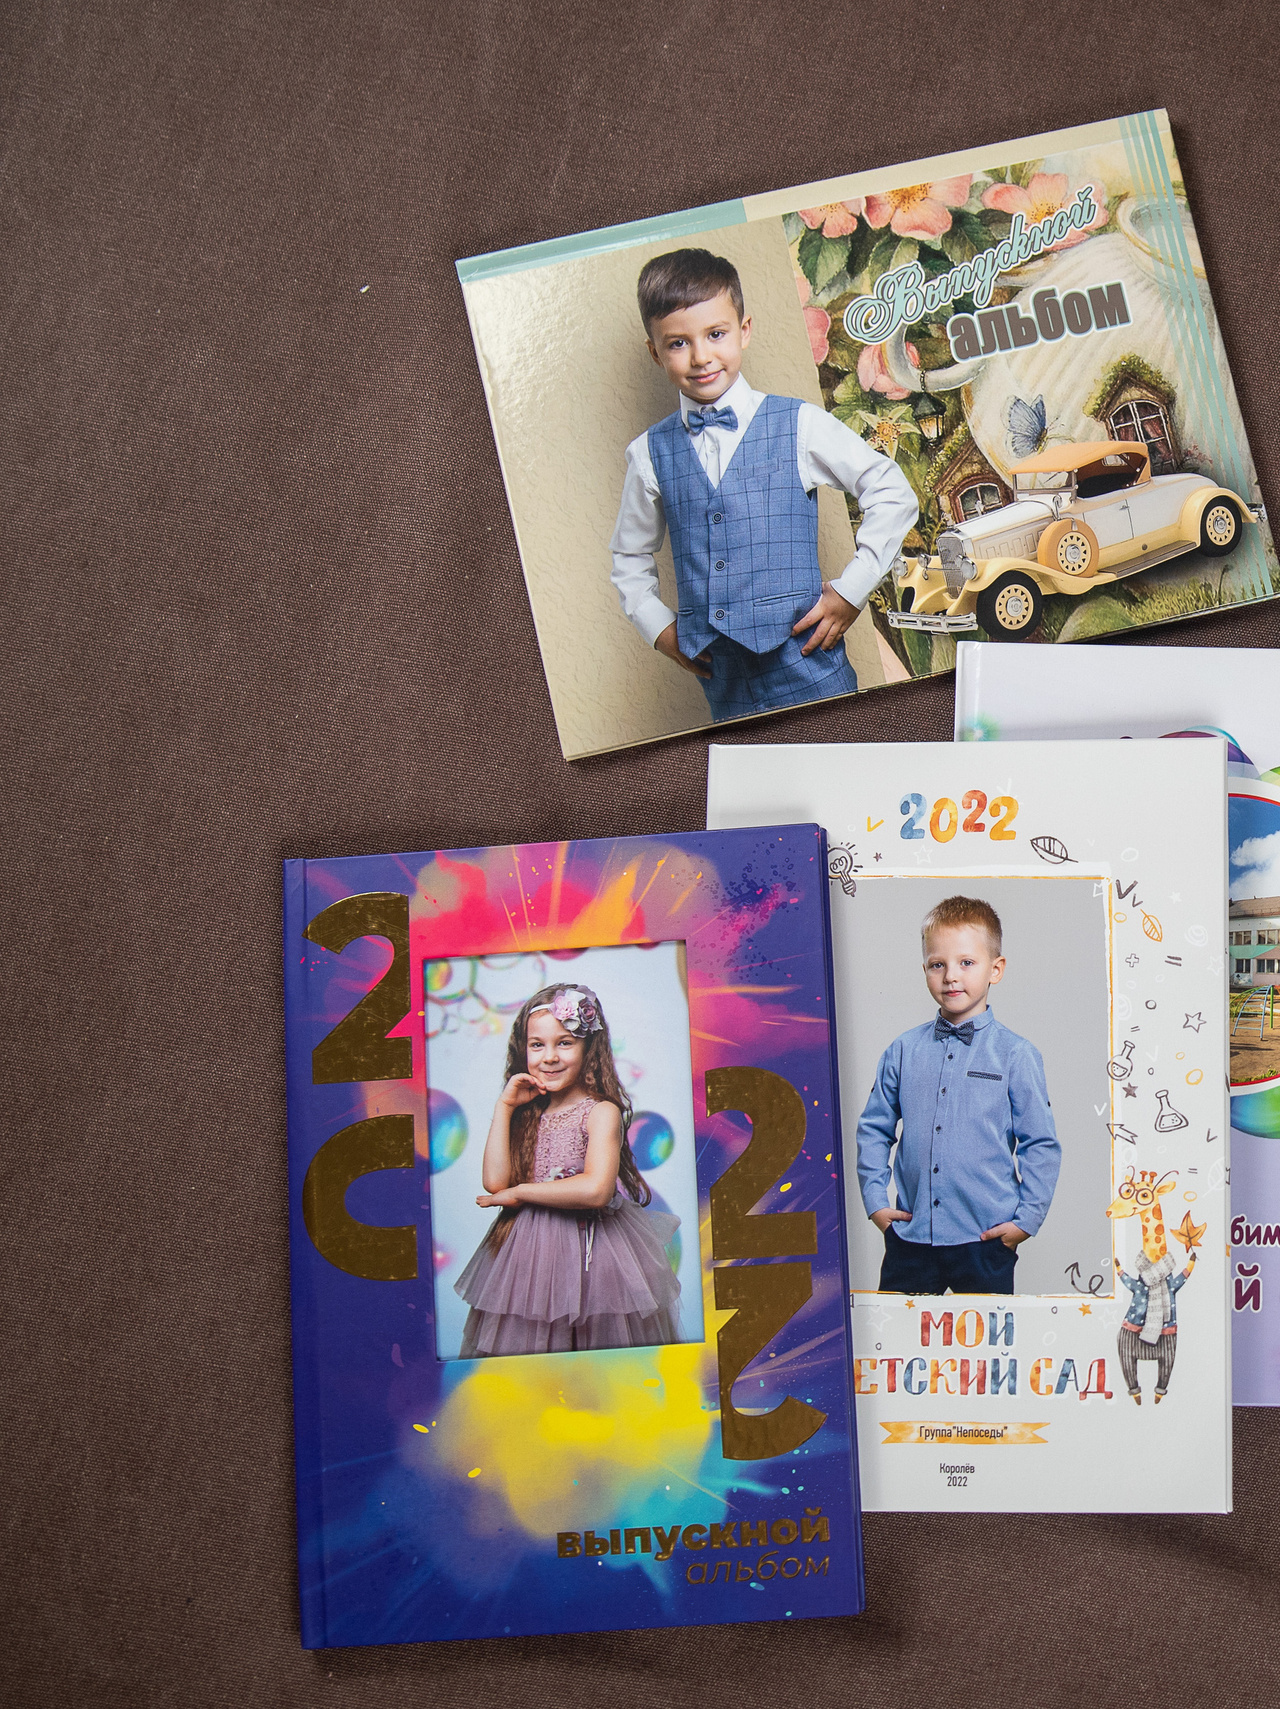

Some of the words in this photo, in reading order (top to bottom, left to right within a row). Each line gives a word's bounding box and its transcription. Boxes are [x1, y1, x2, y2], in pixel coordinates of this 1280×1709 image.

[845, 186, 1097, 343] Выпускной
[951, 282, 1131, 361] альбом
[899, 789, 1020, 843] 2022
[920, 1305, 1015, 1347] МОЙ
[853, 1351, 1018, 1396] ЕТСКИЙ
[1029, 1357, 1114, 1401] САД
[939, 1462, 976, 1476] Королёв
[946, 1476, 968, 1487] 2022
[556, 1506, 831, 1562] выпускной
[685, 1550, 830, 1585] альбом
